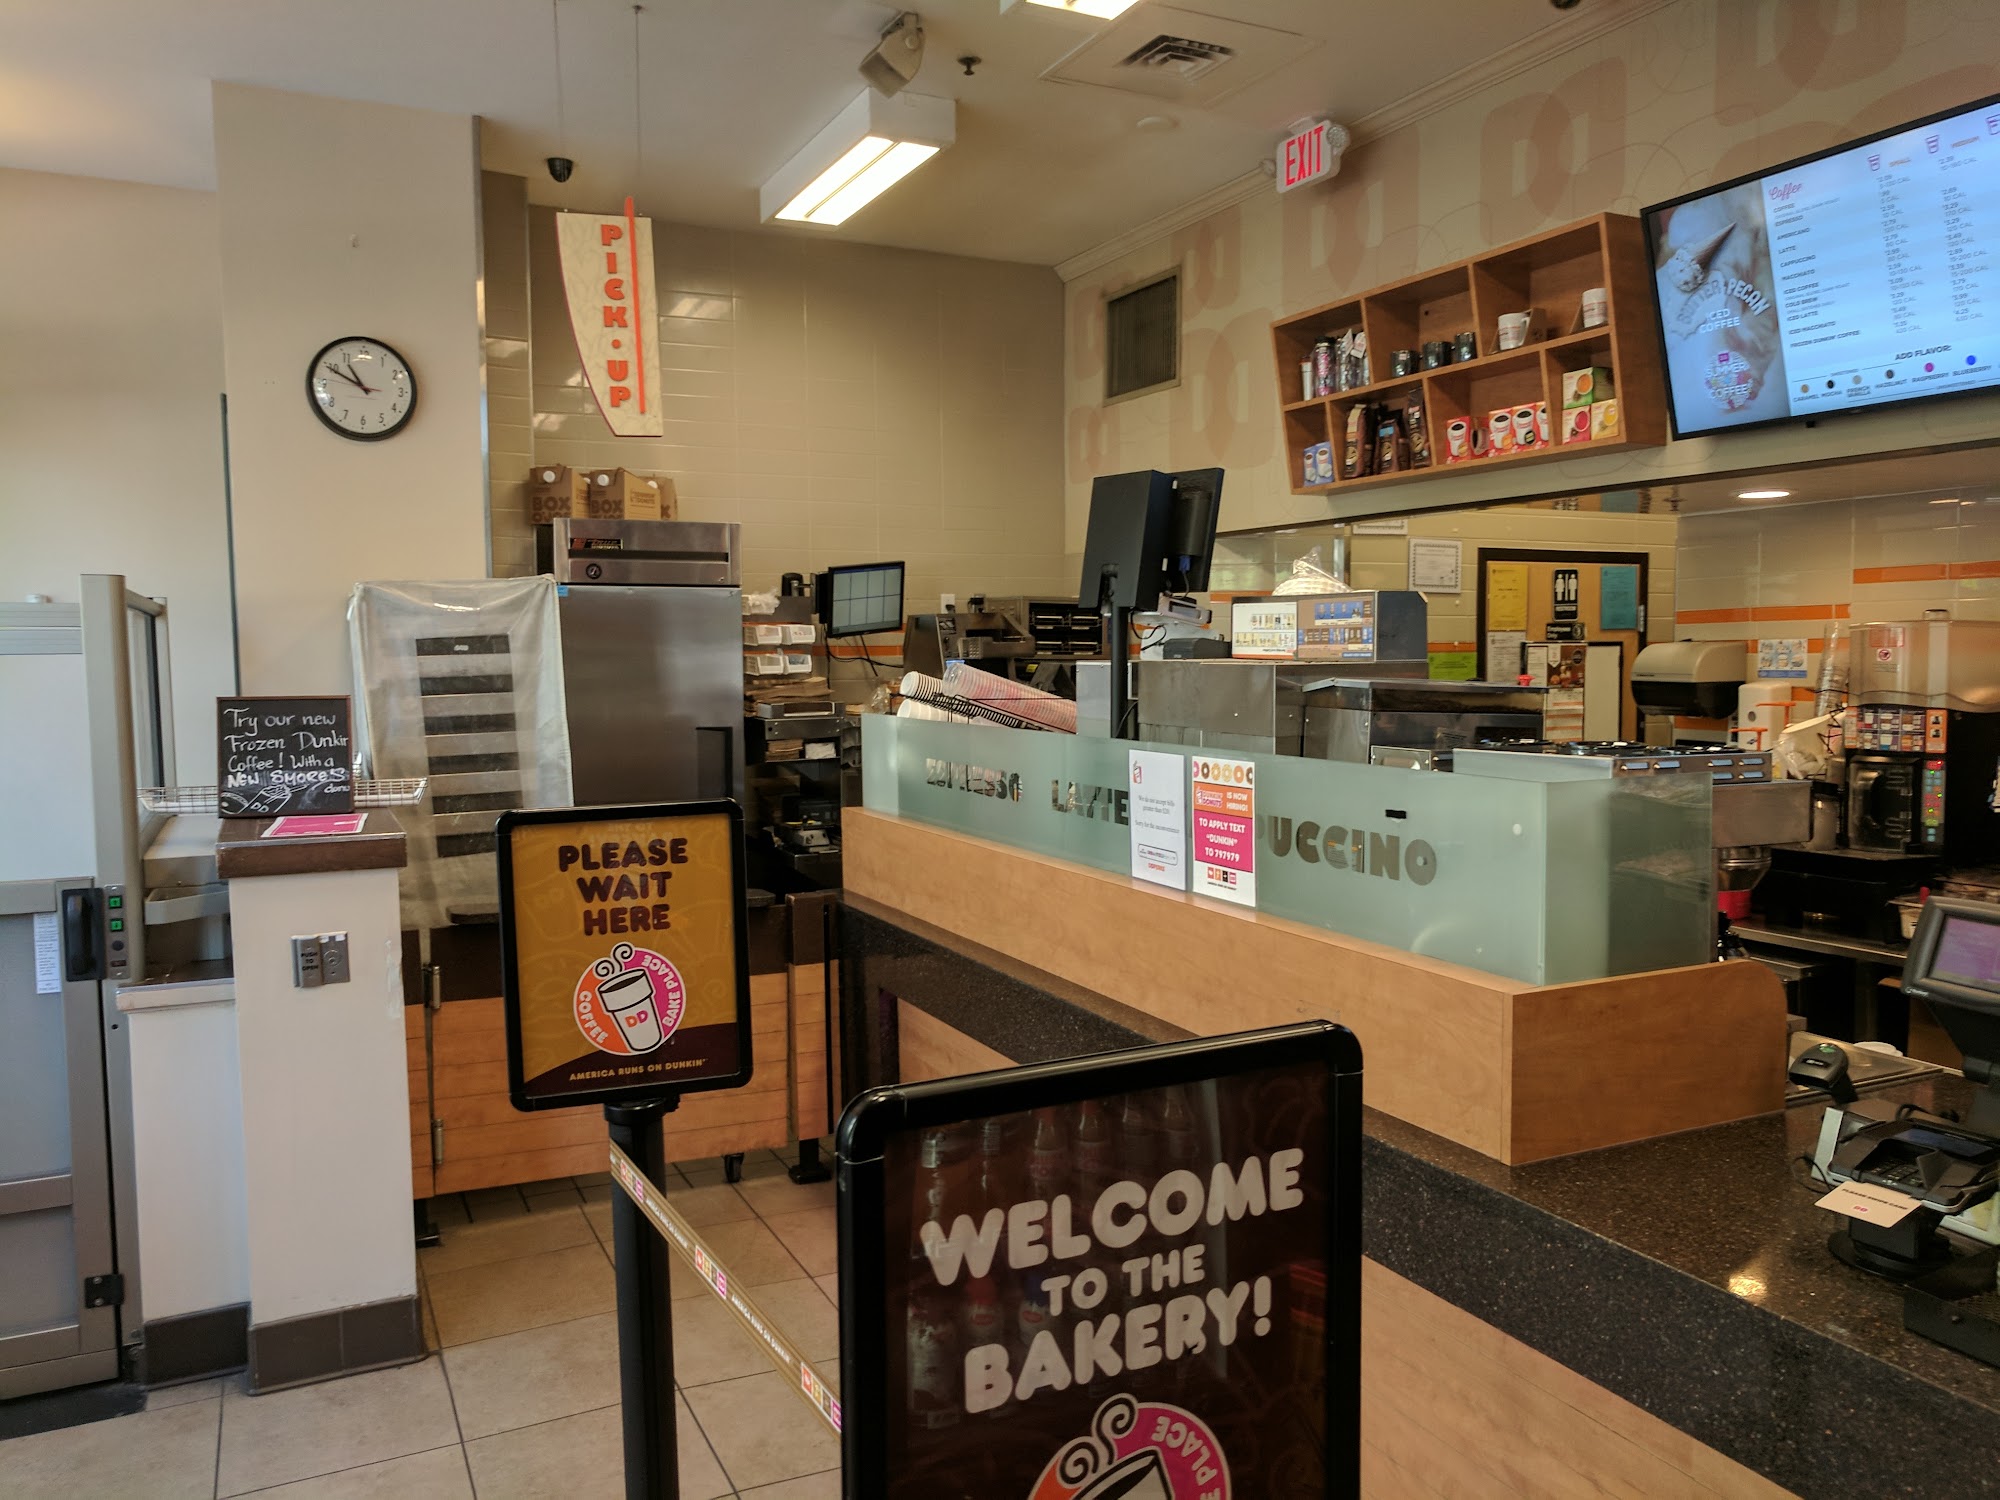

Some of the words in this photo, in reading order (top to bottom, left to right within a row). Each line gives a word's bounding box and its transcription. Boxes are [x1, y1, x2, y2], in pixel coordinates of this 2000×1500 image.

[1286, 125, 1324, 187] EXIT
[1768, 182, 1802, 200] Coffee
[601, 224, 628, 328] PICK
[1727, 278, 1771, 316] PECAN
[1700, 317, 1740, 333] COFFEE
[342, 352, 351, 363] 11
[381, 357, 385, 368] 1
[1895, 350, 1913, 361] ADD
[393, 370, 398, 380] 2
[1952, 365, 1992, 377] BLUEBERRY
[398, 387, 404, 398] 3
[607, 360, 631, 408] UP
[329, 397, 335, 407] 8
[391, 403, 397, 412] 4
[343, 409, 349, 420] 7
[361, 415, 366, 426] 6
[379, 413, 385, 424] 5
[532, 496, 571, 511] BOX
[591, 500, 623, 513] BOX
[223, 708, 258, 736] Try
[264, 714, 296, 727] our
[302, 714, 336, 726] new
[224, 735, 286, 753] Frozen
[290, 754, 322, 770] With
[324, 758, 334, 768] a
[1233, 793, 1248, 801] NOW
[251, 801, 269, 813] DD
[1051, 779, 1129, 826] LATTE
[1257, 813, 1437, 886] UCCINO
[1199, 818, 1208, 827] TO
[1209, 820, 1228, 830] APPLY
[1229, 823, 1246, 833] TEXT
[558, 838, 688, 872] PLEASE
[1205, 847, 1213, 857] TO
[1214, 849, 1240, 862] 797979
[576, 871, 672, 904] WAIT
[583, 904, 671, 936] HERE
[641, 954, 679, 990] PLACE
[579, 990, 608, 1044] COFFEE
[662, 990, 681, 1027] BAKE
[625, 1010, 648, 1028] DD
[569, 1069, 615, 1081] AMERICA
[618, 1065, 644, 1076] RUNS
[647, 1063, 662, 1072] ON
[1842, 1188, 1867, 1198] PLEASE
[920, 1147, 1304, 1287] WELCOME
[1041, 1267, 1109, 1316] TO
[1122, 1243, 1206, 1298] THE
[964, 1275, 1273, 1414] BAKERY!
[1151, 1415, 1217, 1486] PLACE
